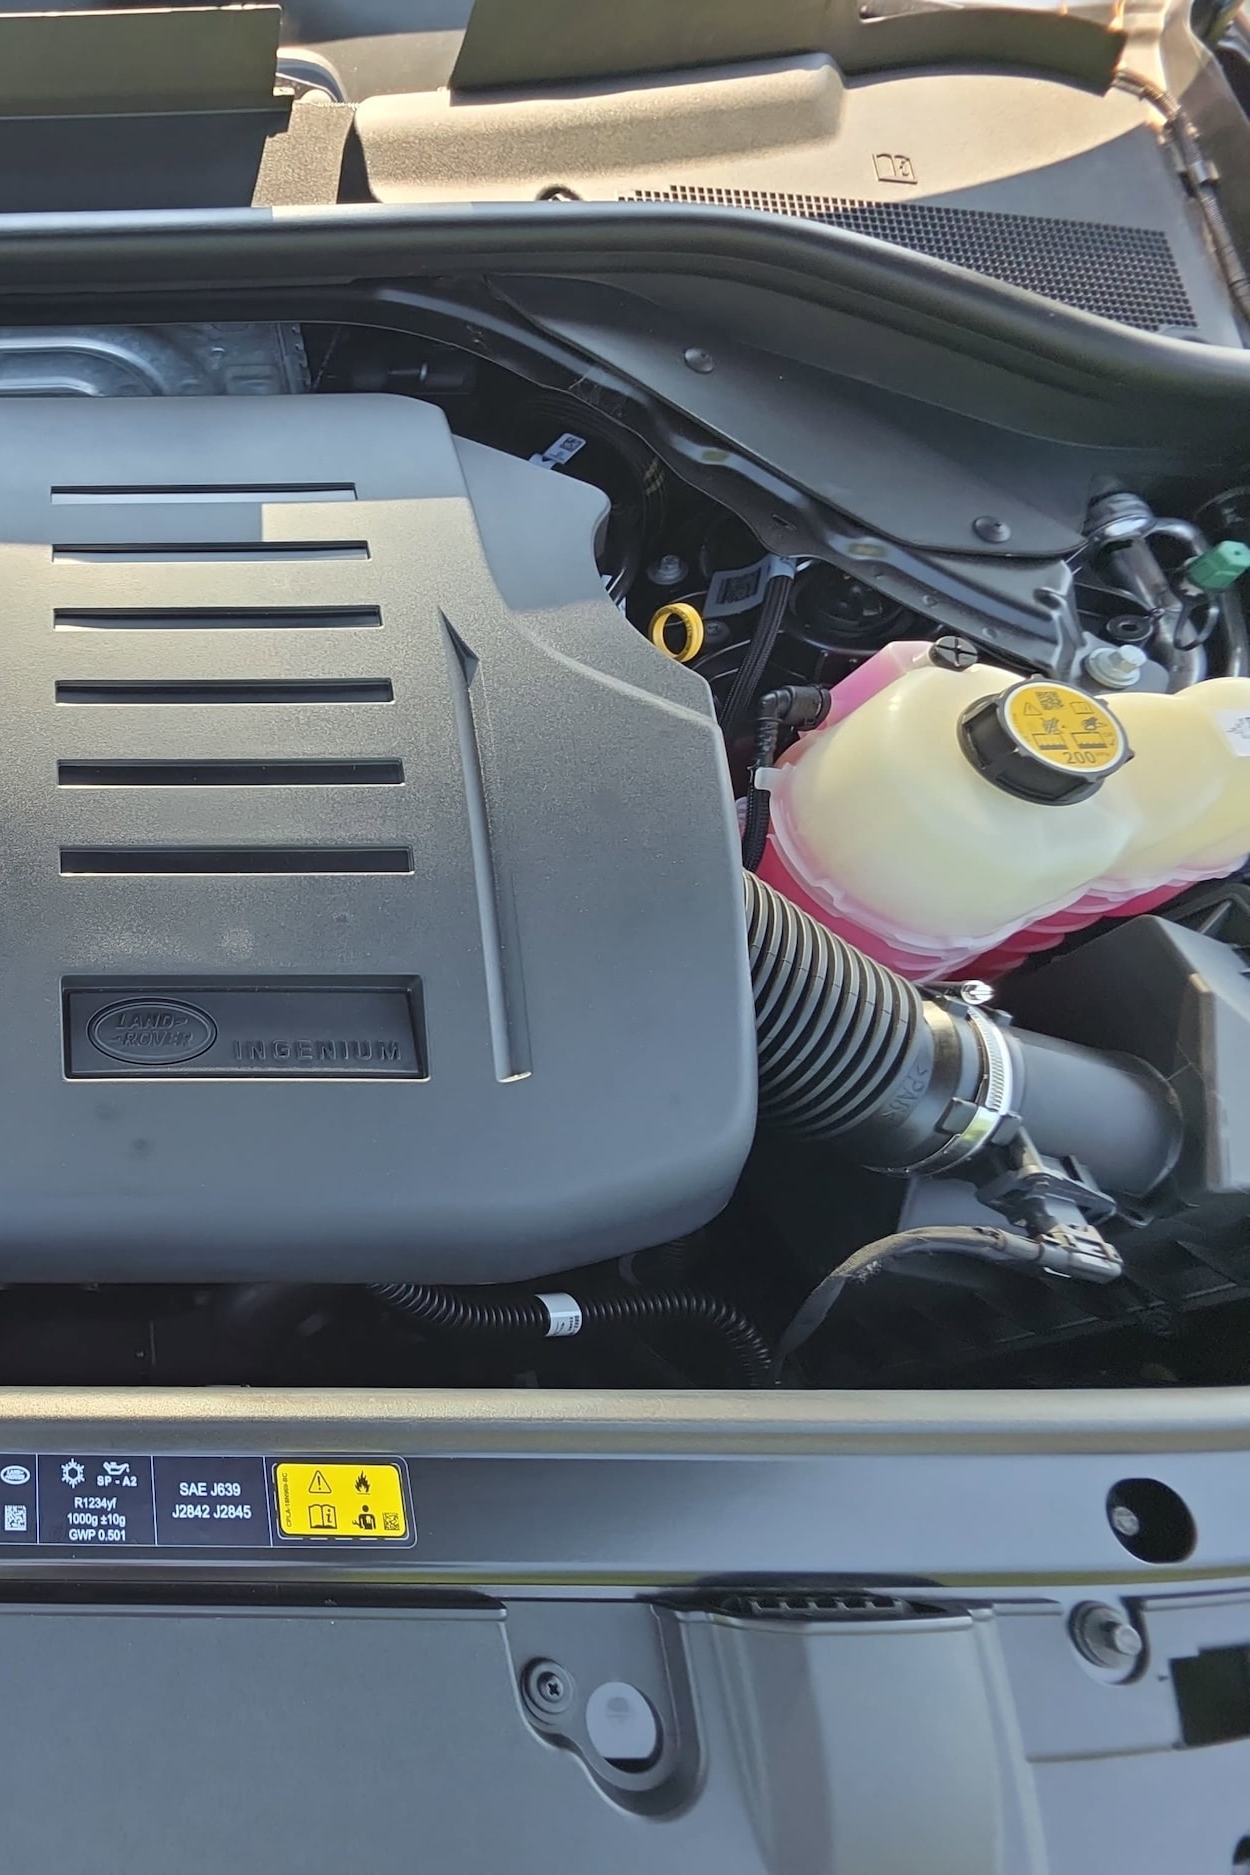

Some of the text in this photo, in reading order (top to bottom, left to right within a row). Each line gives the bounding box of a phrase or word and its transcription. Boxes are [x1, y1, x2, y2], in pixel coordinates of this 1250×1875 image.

[1062, 751, 1097, 765] 200
[116, 1012, 175, 1030] LAND
[123, 1030, 194, 1047] ROVER
[232, 1038, 403, 1062] INGENIUM
[96, 1475, 112, 1486] SP
[122, 1475, 137, 1487] A2
[179, 1482, 241, 1497] SAE J639
[74, 1497, 117, 1511] R1234yf
[172, 1504, 251, 1519] J2842 J2845
[67, 1512, 126, 1527] 1000g ±10g
[68, 1528, 126, 1541] GWP 0.501
